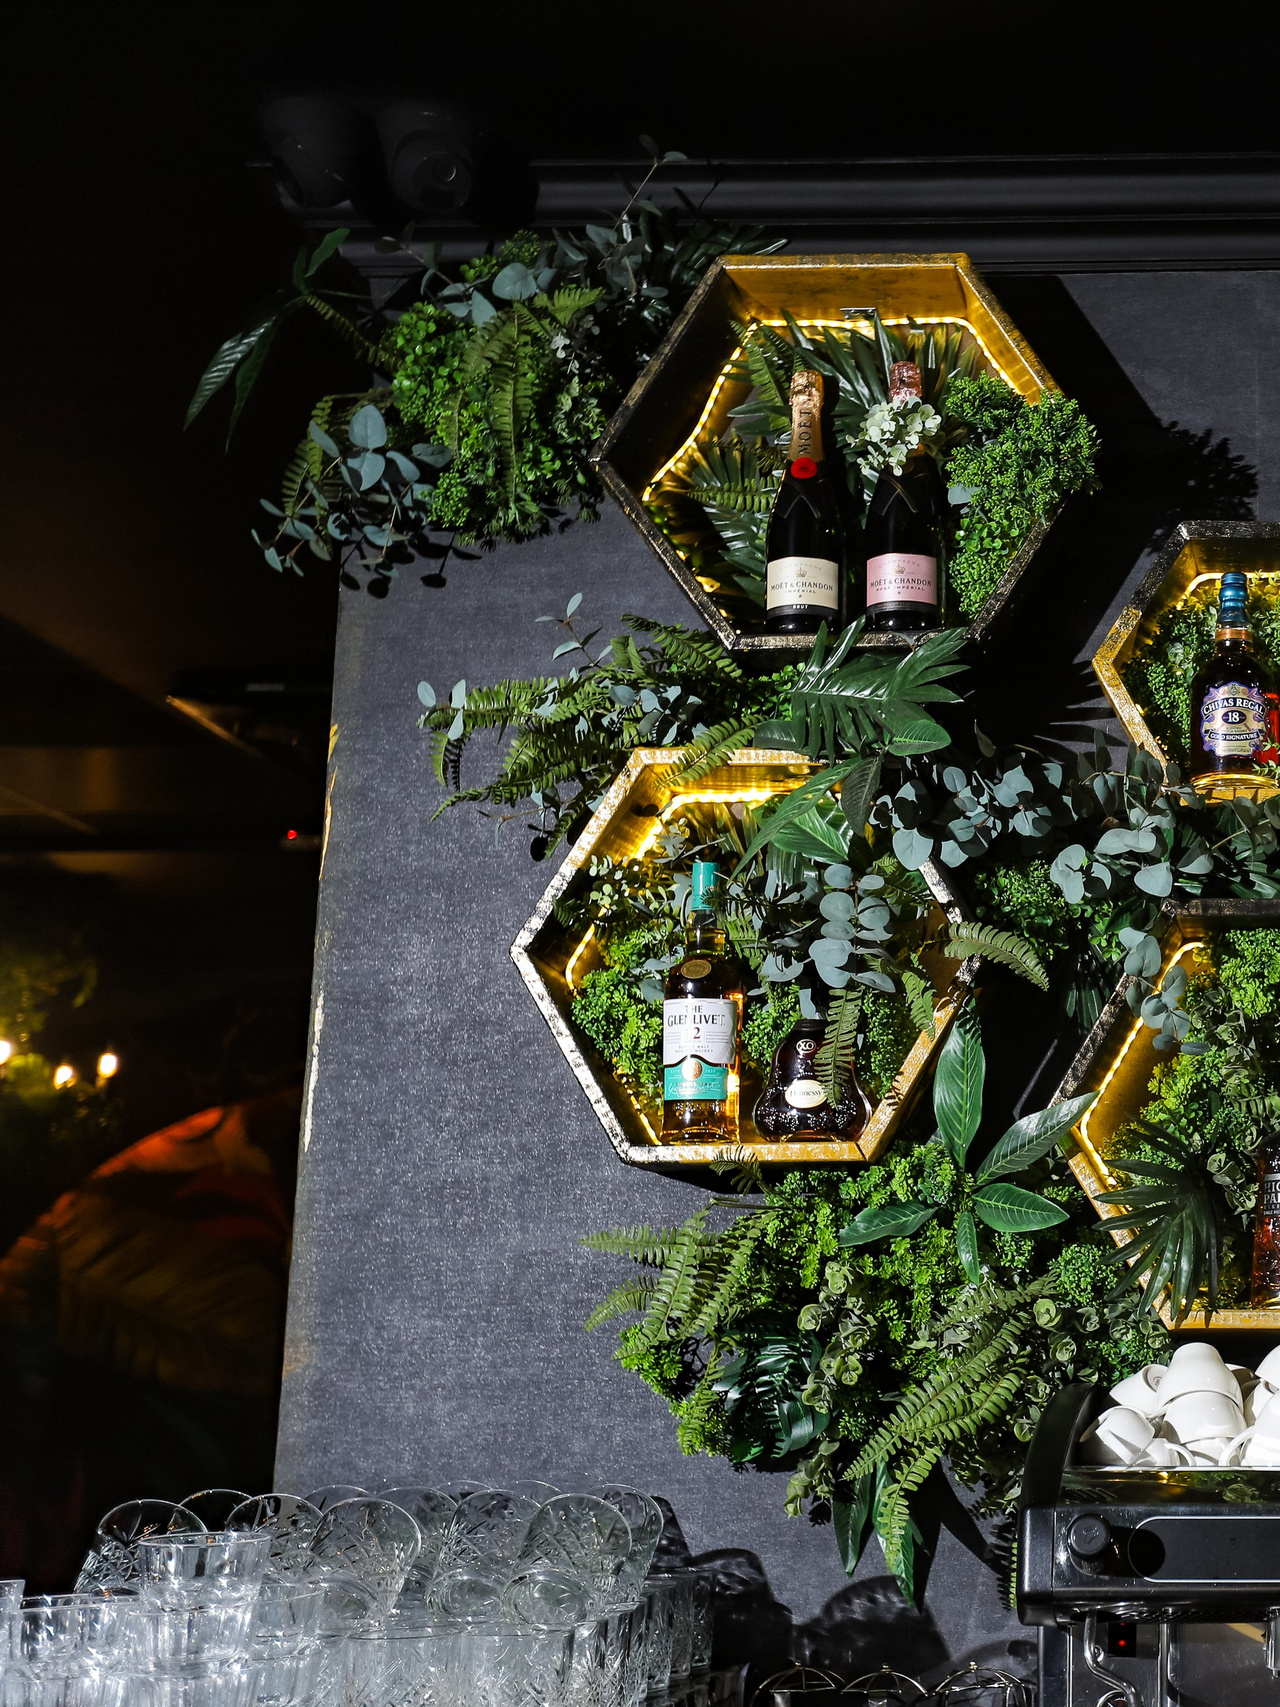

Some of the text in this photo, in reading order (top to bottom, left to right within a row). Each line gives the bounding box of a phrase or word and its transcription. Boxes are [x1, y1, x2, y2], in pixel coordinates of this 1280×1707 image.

[797, 409, 812, 455] MOËT
[795, 580, 834, 591] CHANDON
[894, 577, 932, 588] CHANDON
[1203, 698, 1264, 715] CHIVAS REGAL
[1227, 711, 1240, 723] 18
[1226, 733, 1258, 741] SIGNATURE
[685, 1005, 703, 1013] THE
[799, 1041, 814, 1050] XO
[790, 1090, 822, 1098] Hnnessy
